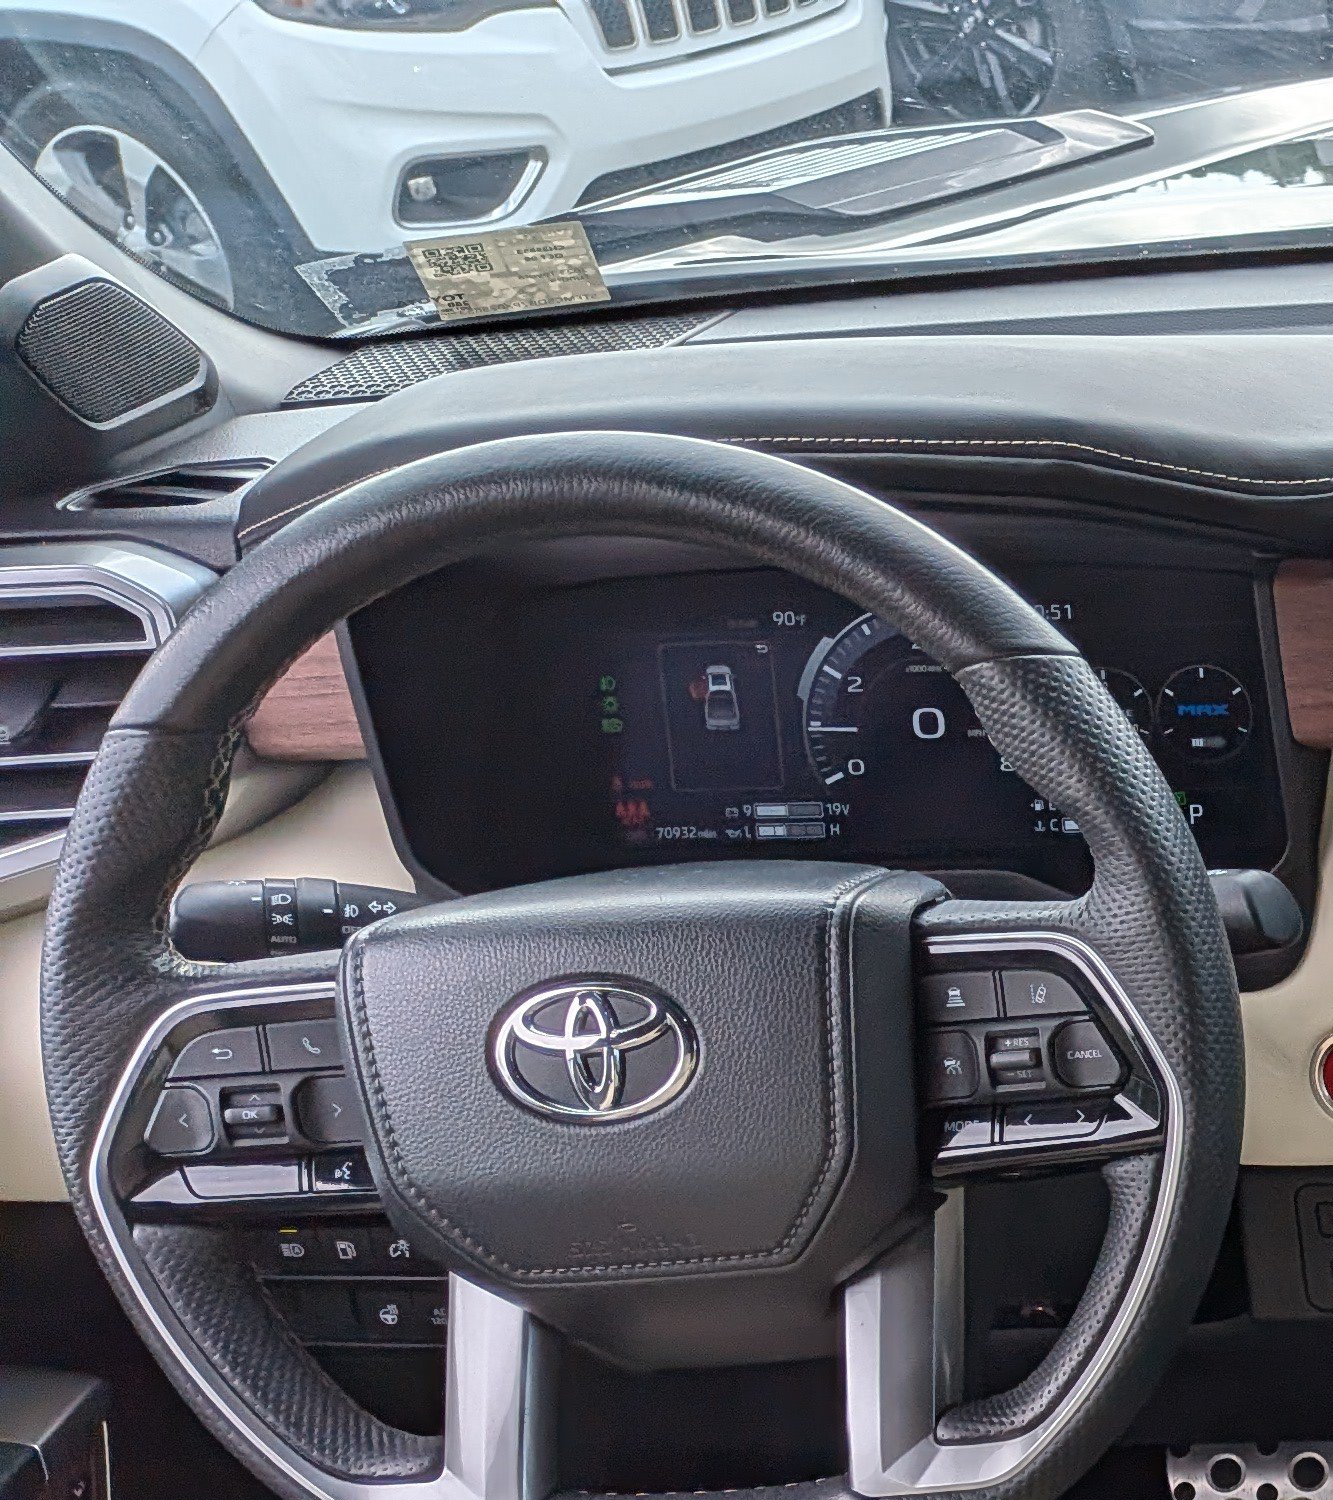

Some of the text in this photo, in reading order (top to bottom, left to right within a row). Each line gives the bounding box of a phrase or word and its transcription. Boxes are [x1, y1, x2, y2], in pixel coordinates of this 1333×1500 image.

[847, 675, 864, 693] 2
[912, 707, 946, 739] 0
[848, 758, 865, 775] 0
[1189, 804, 1204, 825] P
[270, 935, 298, 945] AUTO
[1067, 1049, 1102, 1060] CANCEL
[242, 1109, 259, 1120] OK
